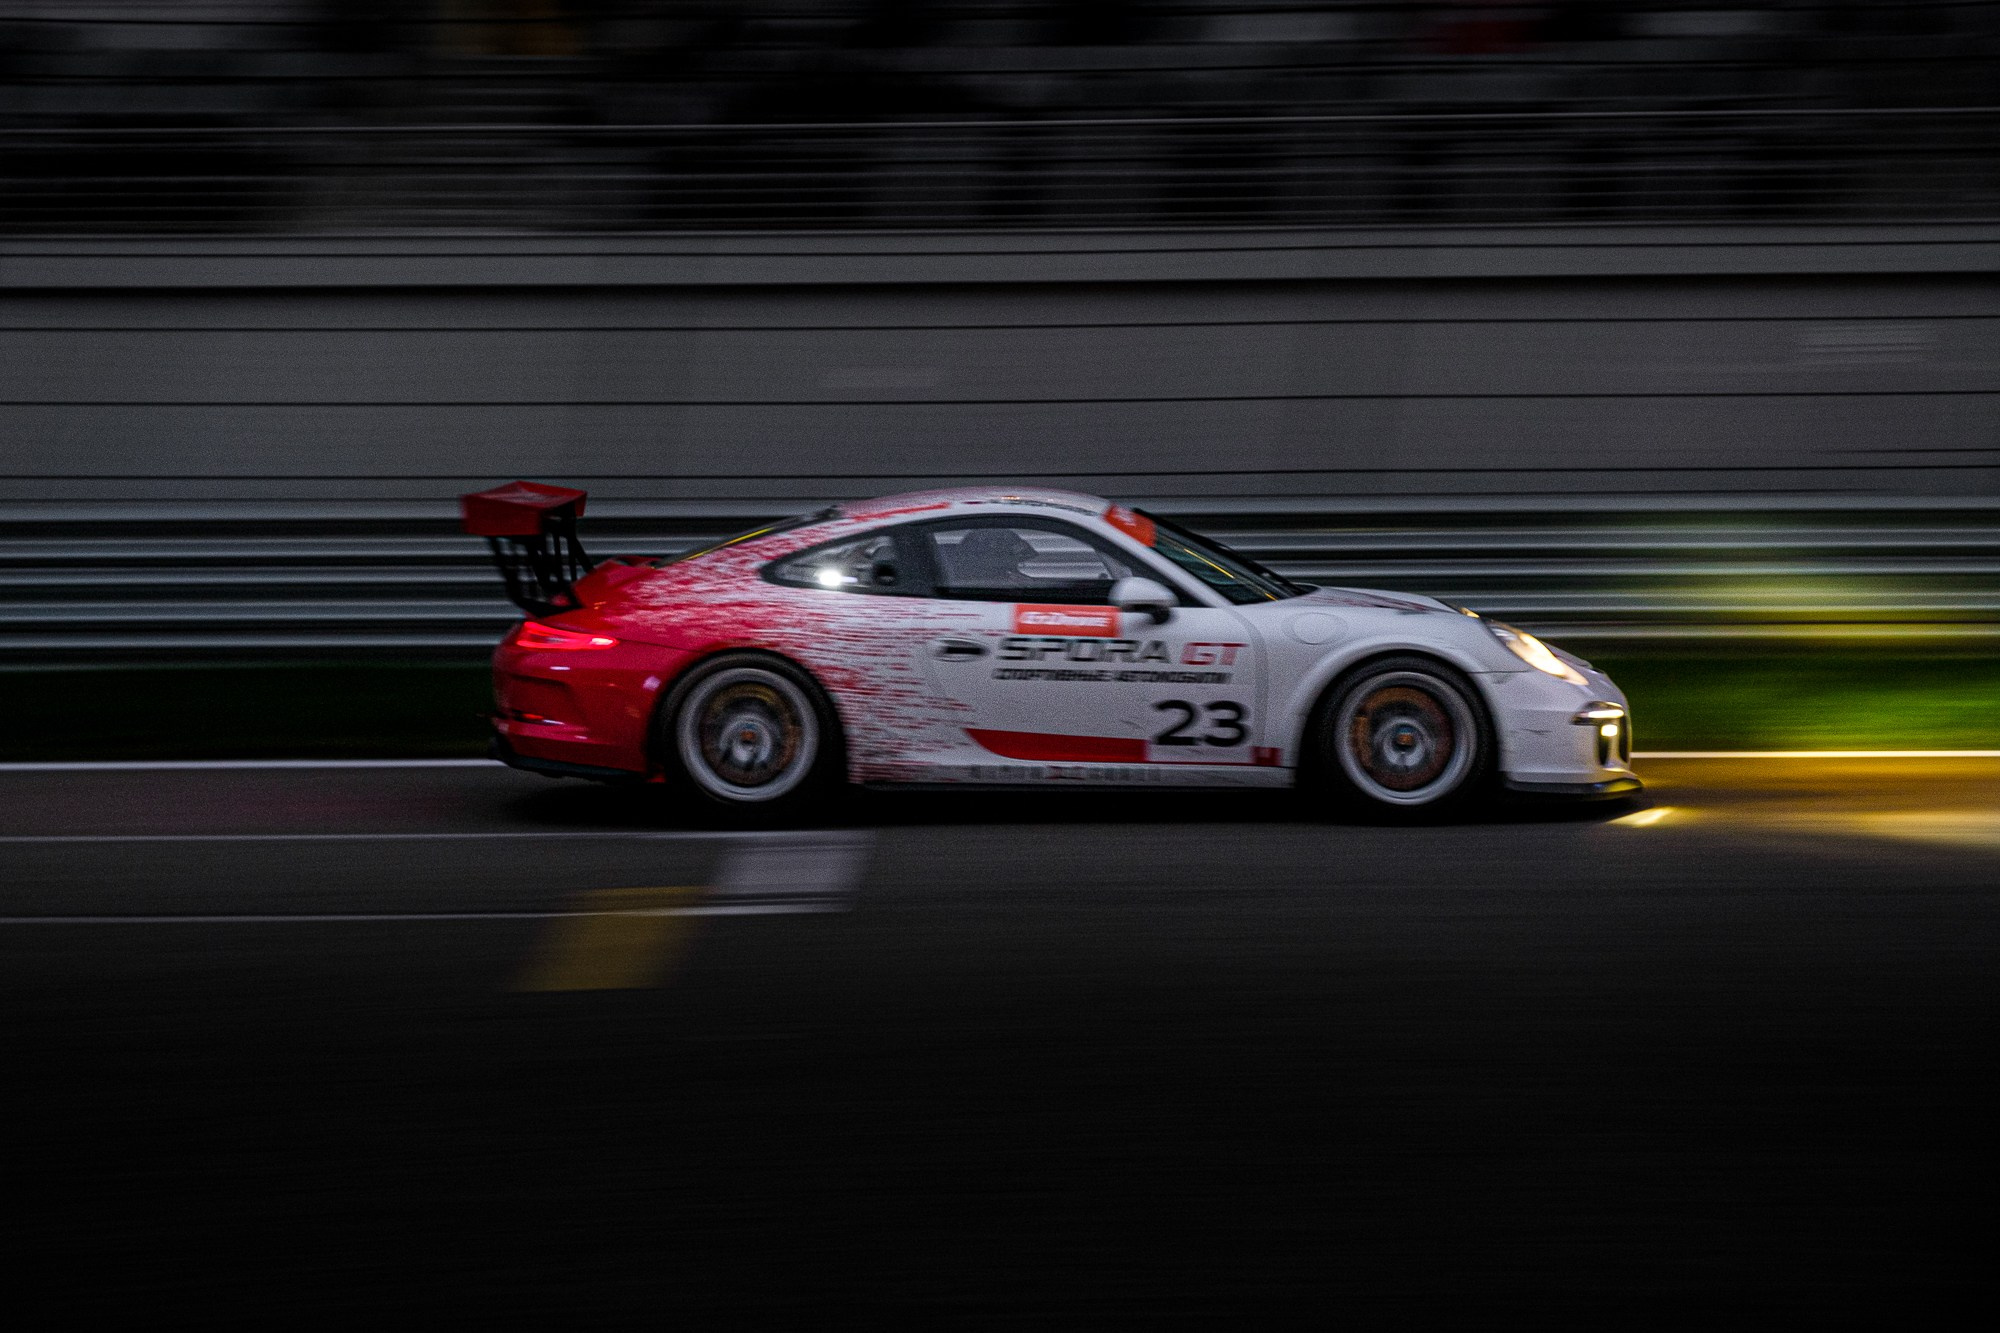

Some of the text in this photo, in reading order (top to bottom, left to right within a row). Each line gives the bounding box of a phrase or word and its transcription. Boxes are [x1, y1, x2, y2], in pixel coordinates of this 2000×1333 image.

[998, 637, 1247, 666] SPORA GT
[1155, 700, 1247, 746] 23
